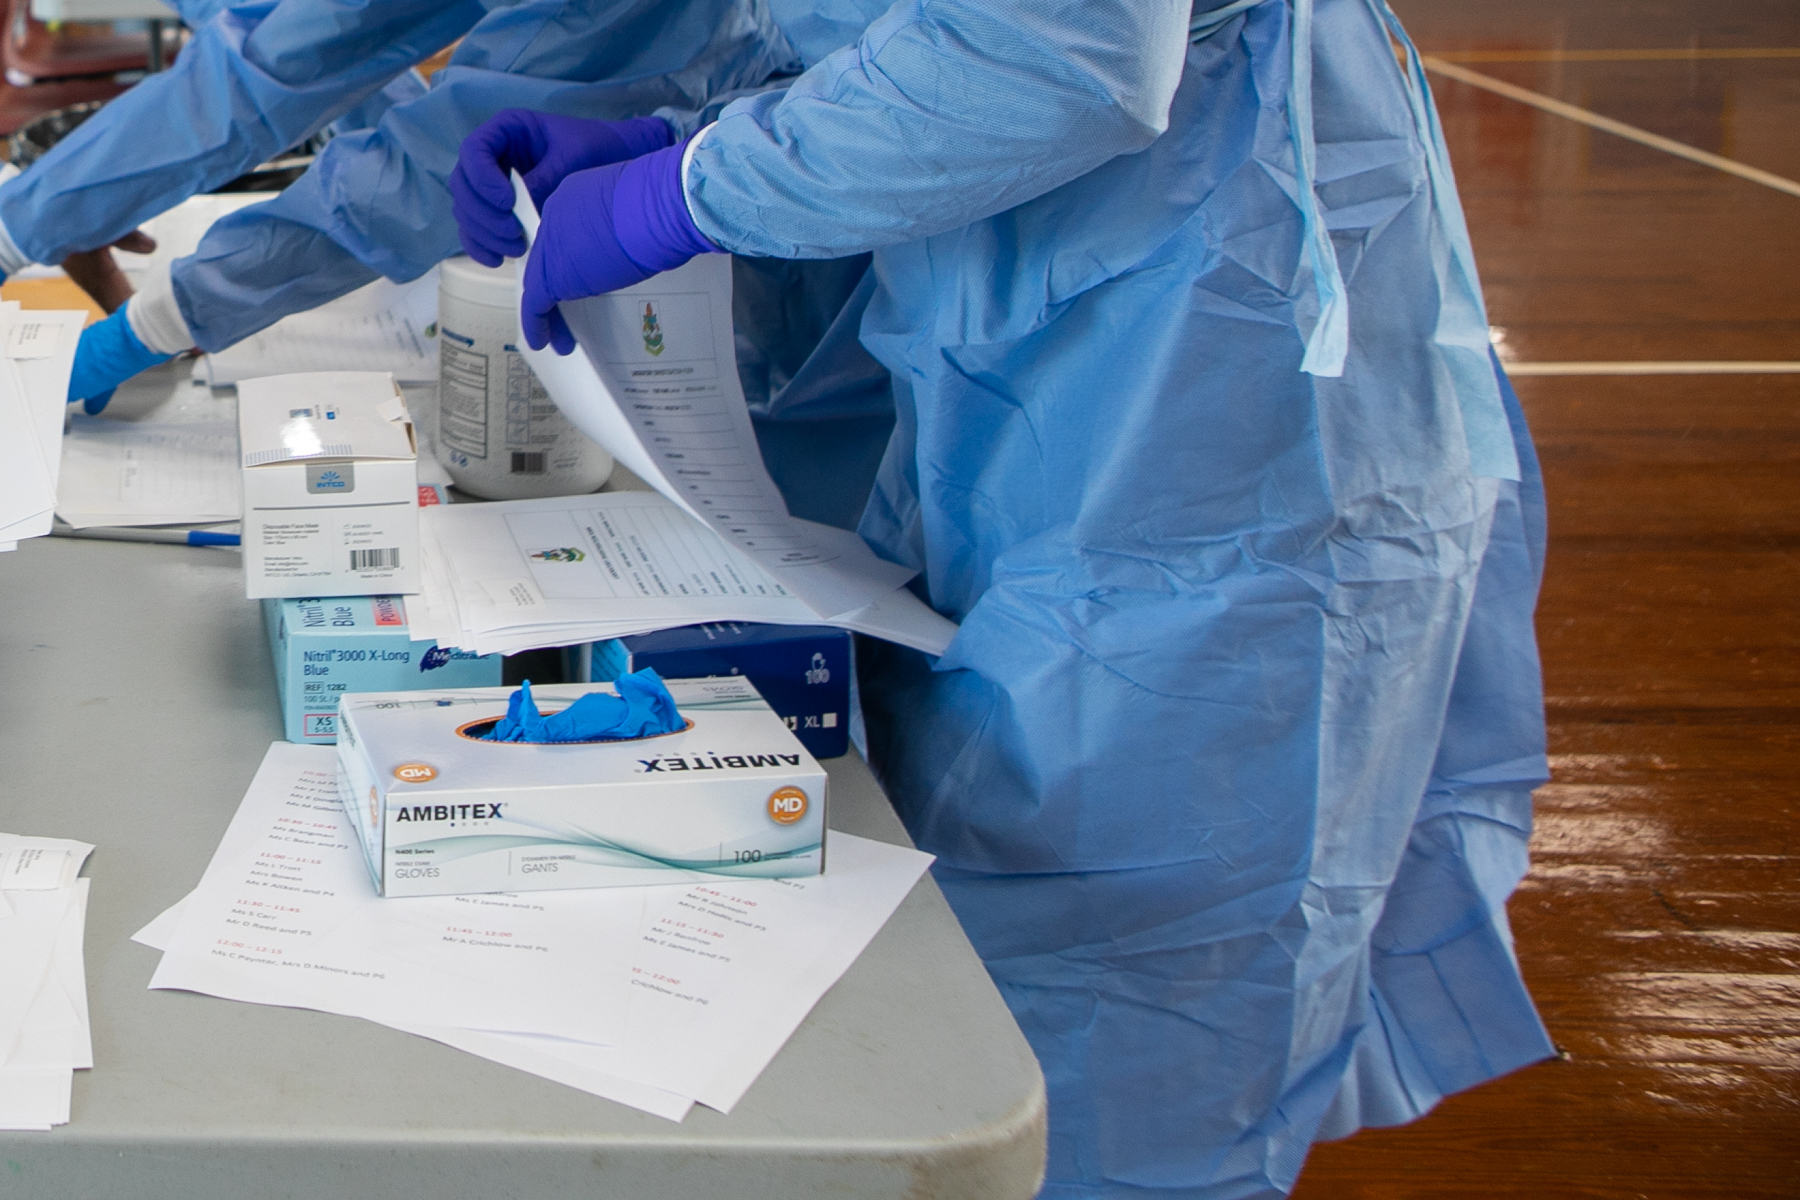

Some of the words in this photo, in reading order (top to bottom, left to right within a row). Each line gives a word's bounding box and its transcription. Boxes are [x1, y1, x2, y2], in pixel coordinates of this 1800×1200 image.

[337, 650, 366, 661] 3000
[368, 649, 410, 664] X-Long
[303, 664, 329, 676] Blue
[805, 668, 831, 685] 100
[326, 683, 347, 691] 1282
[315, 716, 332, 726] XS
[804, 715, 821, 729] XL
[399, 767, 433, 778] MD
[773, 797, 804, 813] MD
[734, 849, 762, 863] 100
[395, 867, 441, 879] GLOVES
[521, 862, 559, 874] GANTS
[252, 923, 277, 932] Reed
